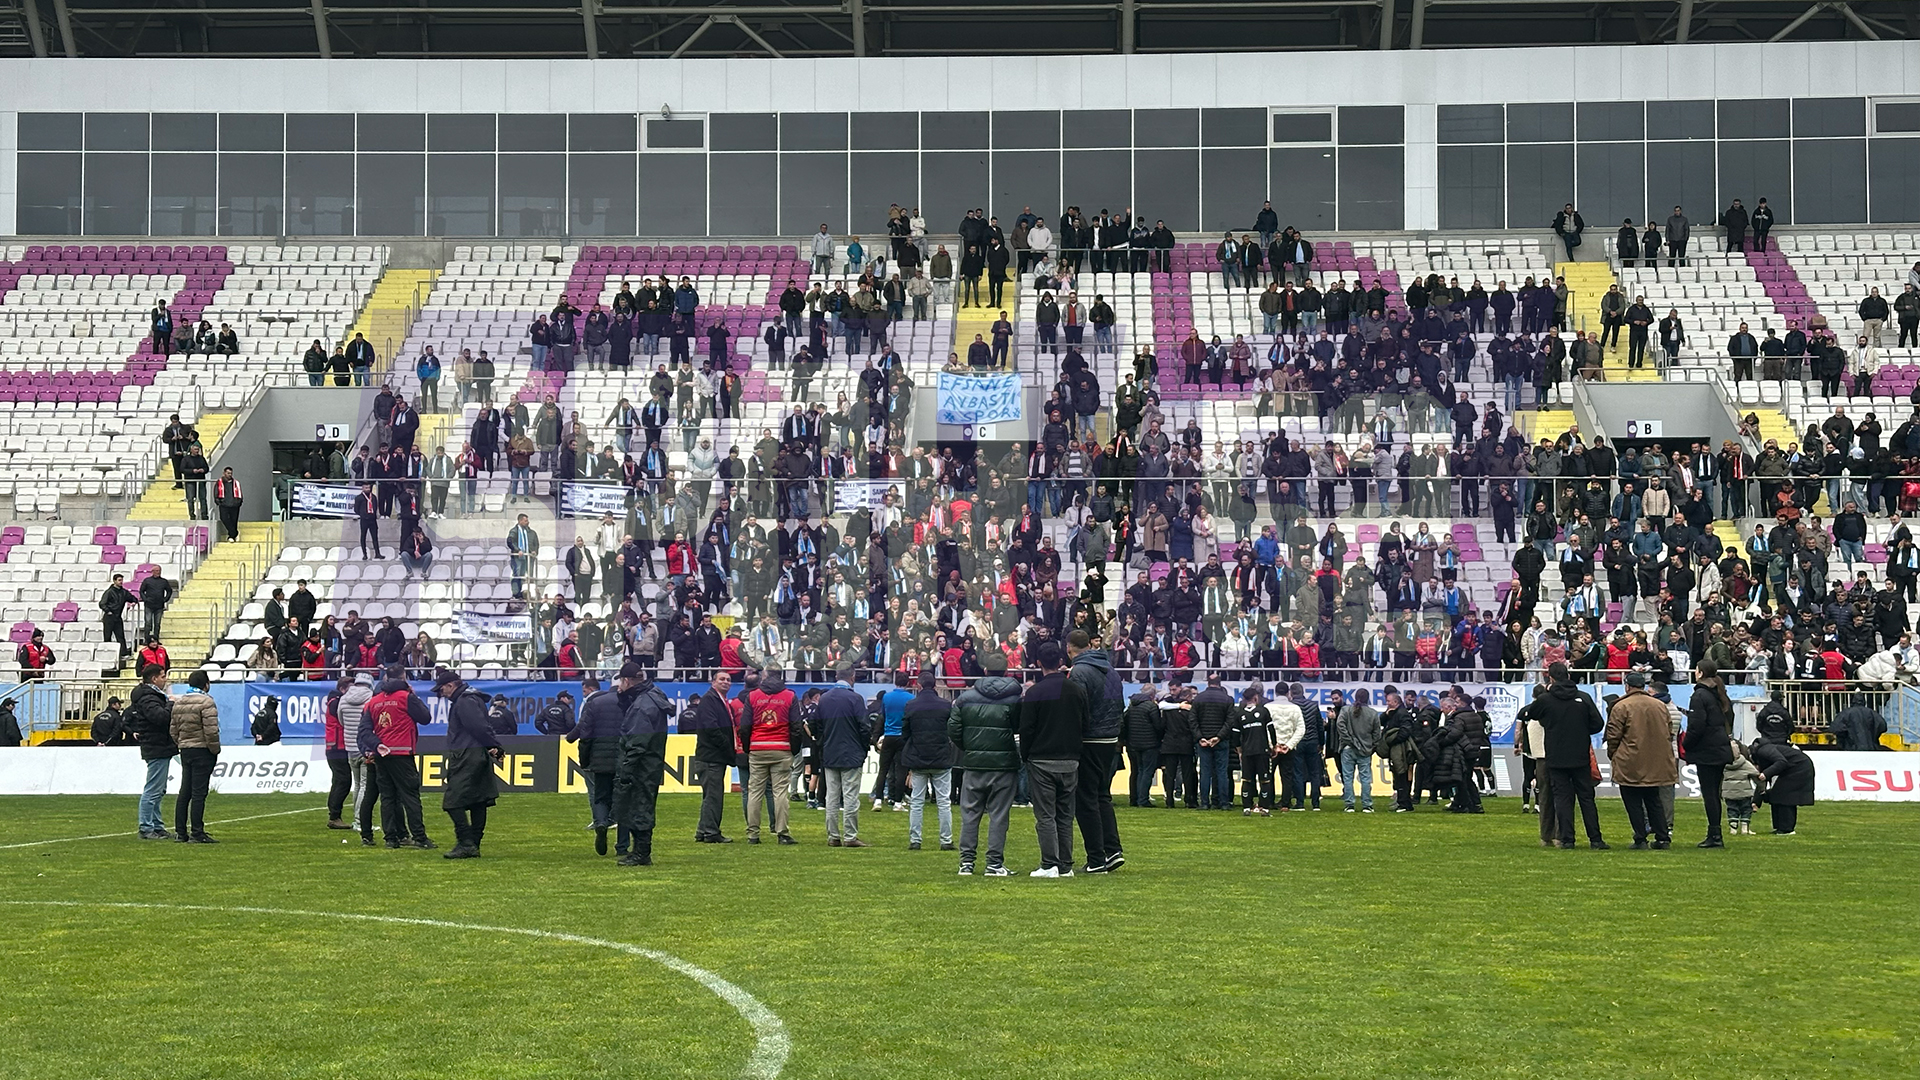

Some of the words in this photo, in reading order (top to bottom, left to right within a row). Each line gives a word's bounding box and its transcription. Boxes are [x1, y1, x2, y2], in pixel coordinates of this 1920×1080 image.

[939, 374, 1016, 392] EFSANE
[943, 392, 1016, 410] AYBASTI
[963, 409, 1011, 422] SPOR
[332, 427, 339, 438] D
[979, 427, 986, 437] C
[1644, 423, 1652, 435] B
[1805, 658, 1814, 674] 9
[212, 760, 309, 778] amsan
[256, 778, 304, 790] entegre
[1836, 769, 1920, 792] ISU
